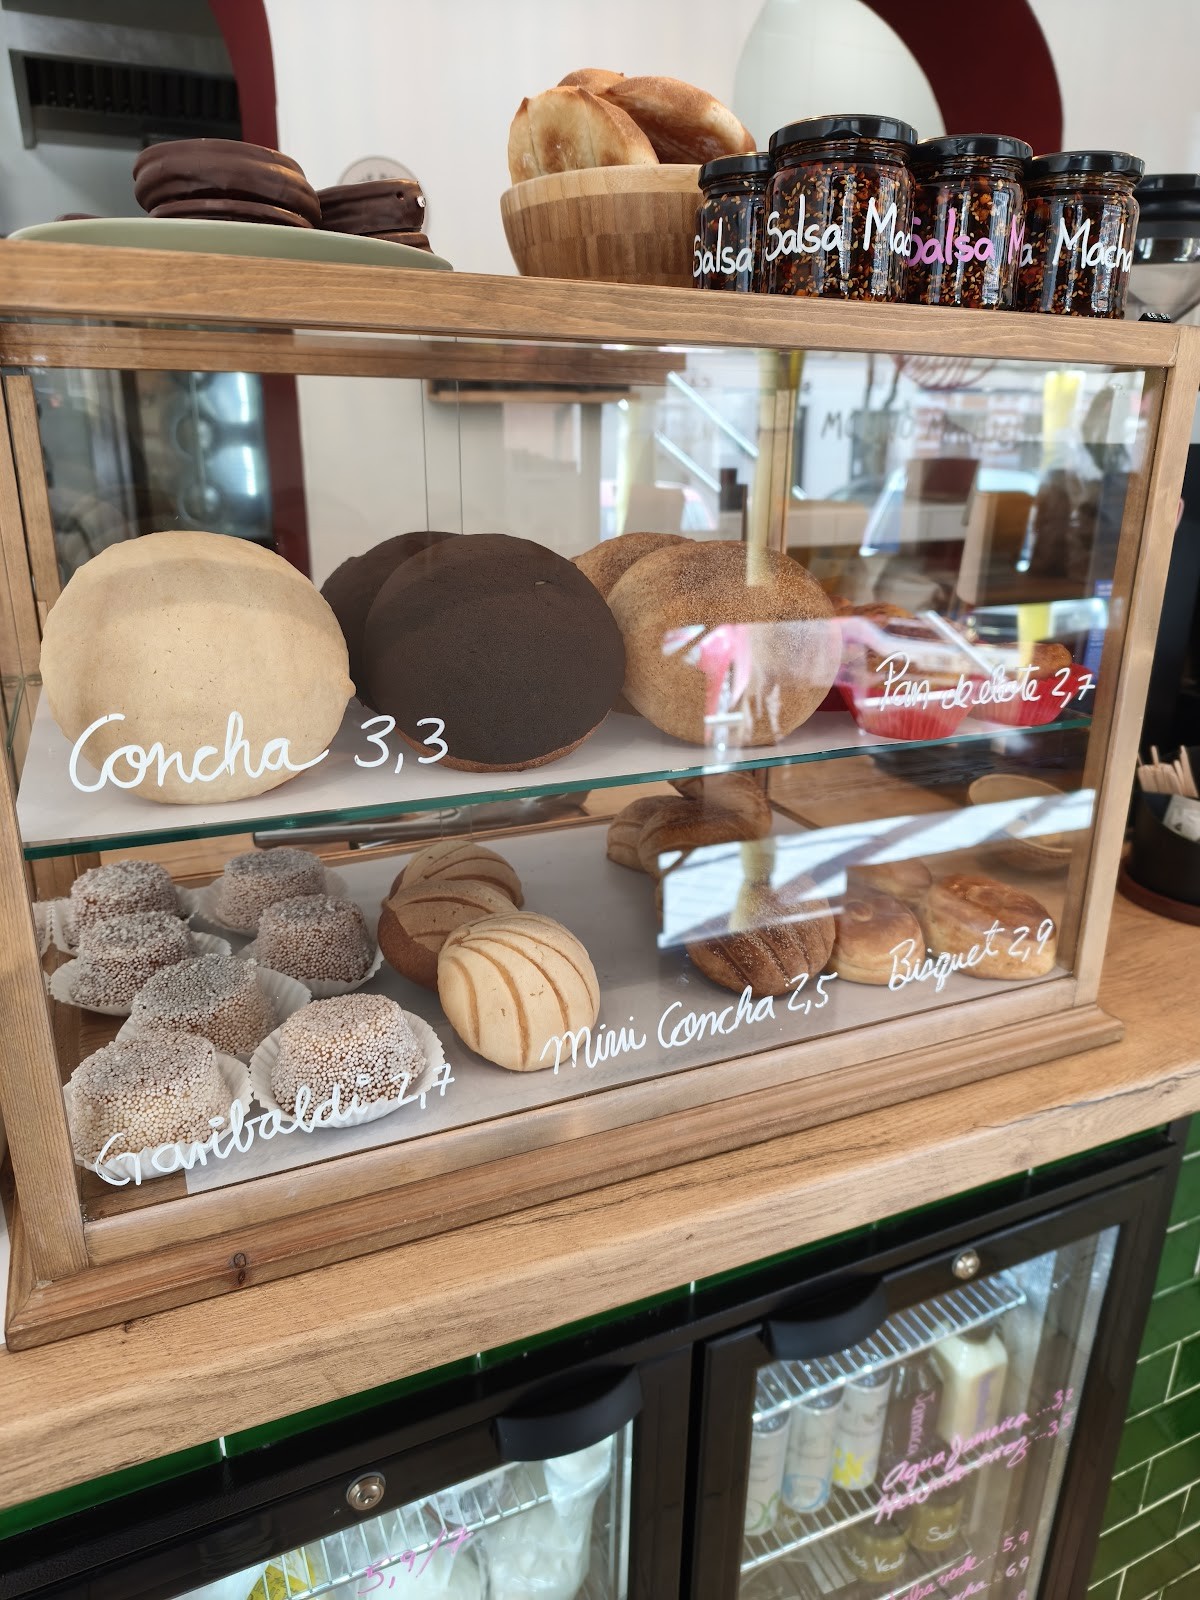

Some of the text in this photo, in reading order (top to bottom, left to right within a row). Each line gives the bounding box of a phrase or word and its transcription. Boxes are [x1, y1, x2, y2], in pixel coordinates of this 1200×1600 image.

[692, 216, 753, 278] Salsa
[763, 193, 843, 262] Salsa
[908, 207, 995, 267] Salsa
[875, 650, 931, 712] Pan
[1051, 667, 1097, 709] 2,7
[68, 710, 450, 793] Concha 3,3
[887, 918, 1054, 993] Bisquet 2,9
[657, 983, 777, 1049] Concha
[786, 971, 839, 1015] 2,5
[94, 1062, 456, 1187] Garibaldi 2,7
